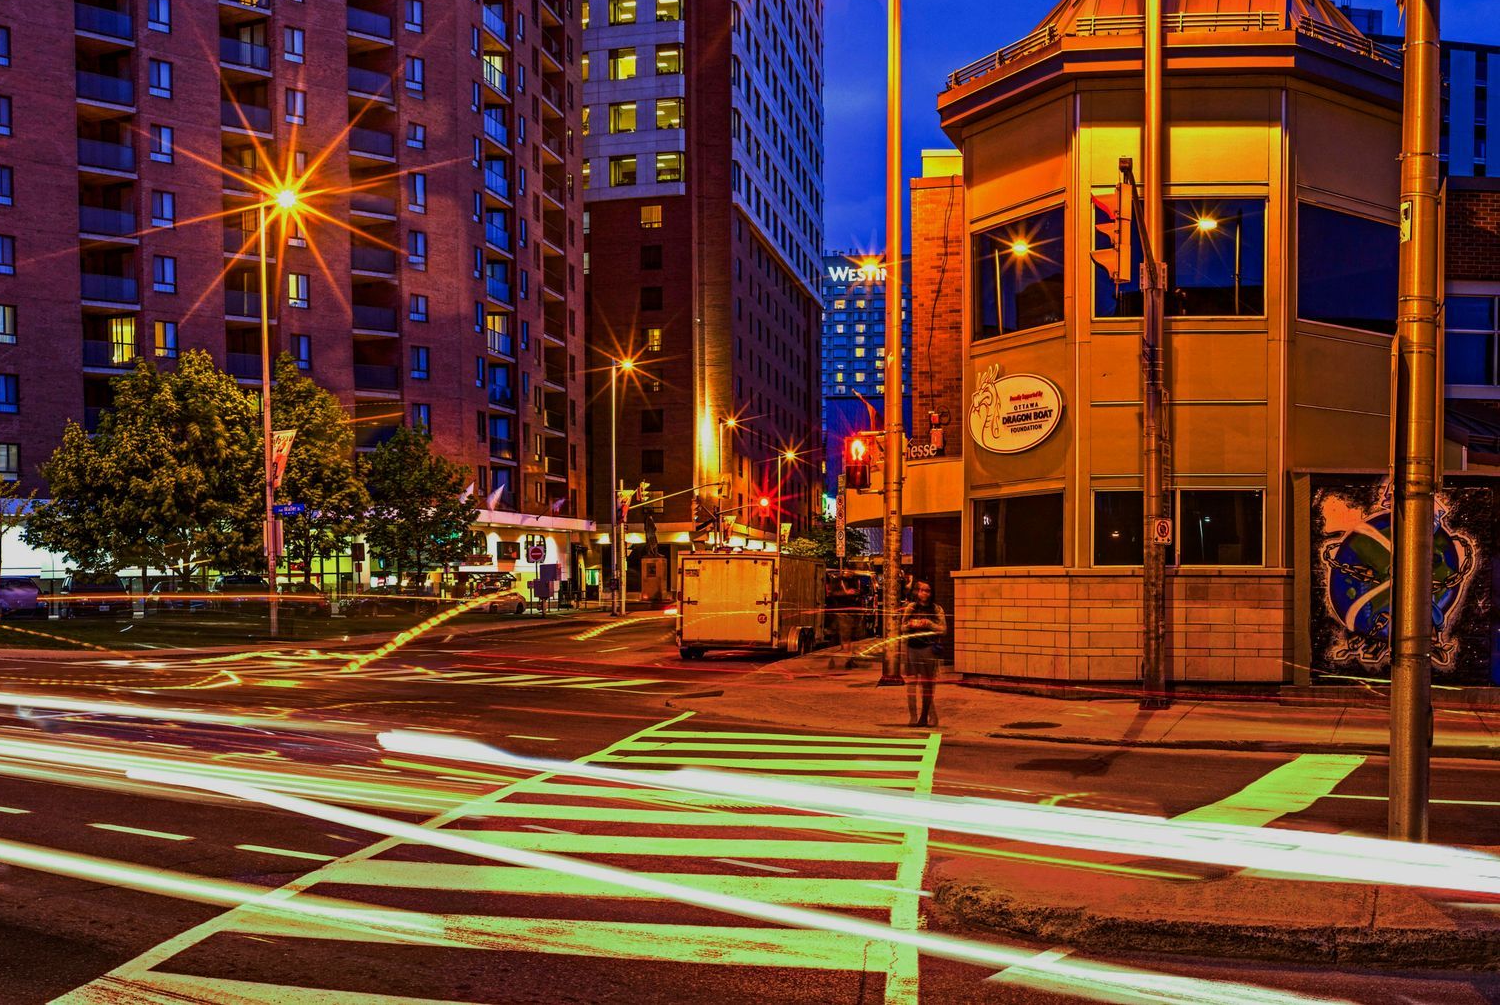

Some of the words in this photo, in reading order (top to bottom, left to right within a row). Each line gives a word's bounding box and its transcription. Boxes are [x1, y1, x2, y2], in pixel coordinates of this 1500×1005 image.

[1013, 402, 1039, 410] OTTAWA
[1002, 412, 1032, 425] DRAGON
[1033, 409, 1053, 420] BOAT
[1010, 424, 1043, 433] FOUNDATION
